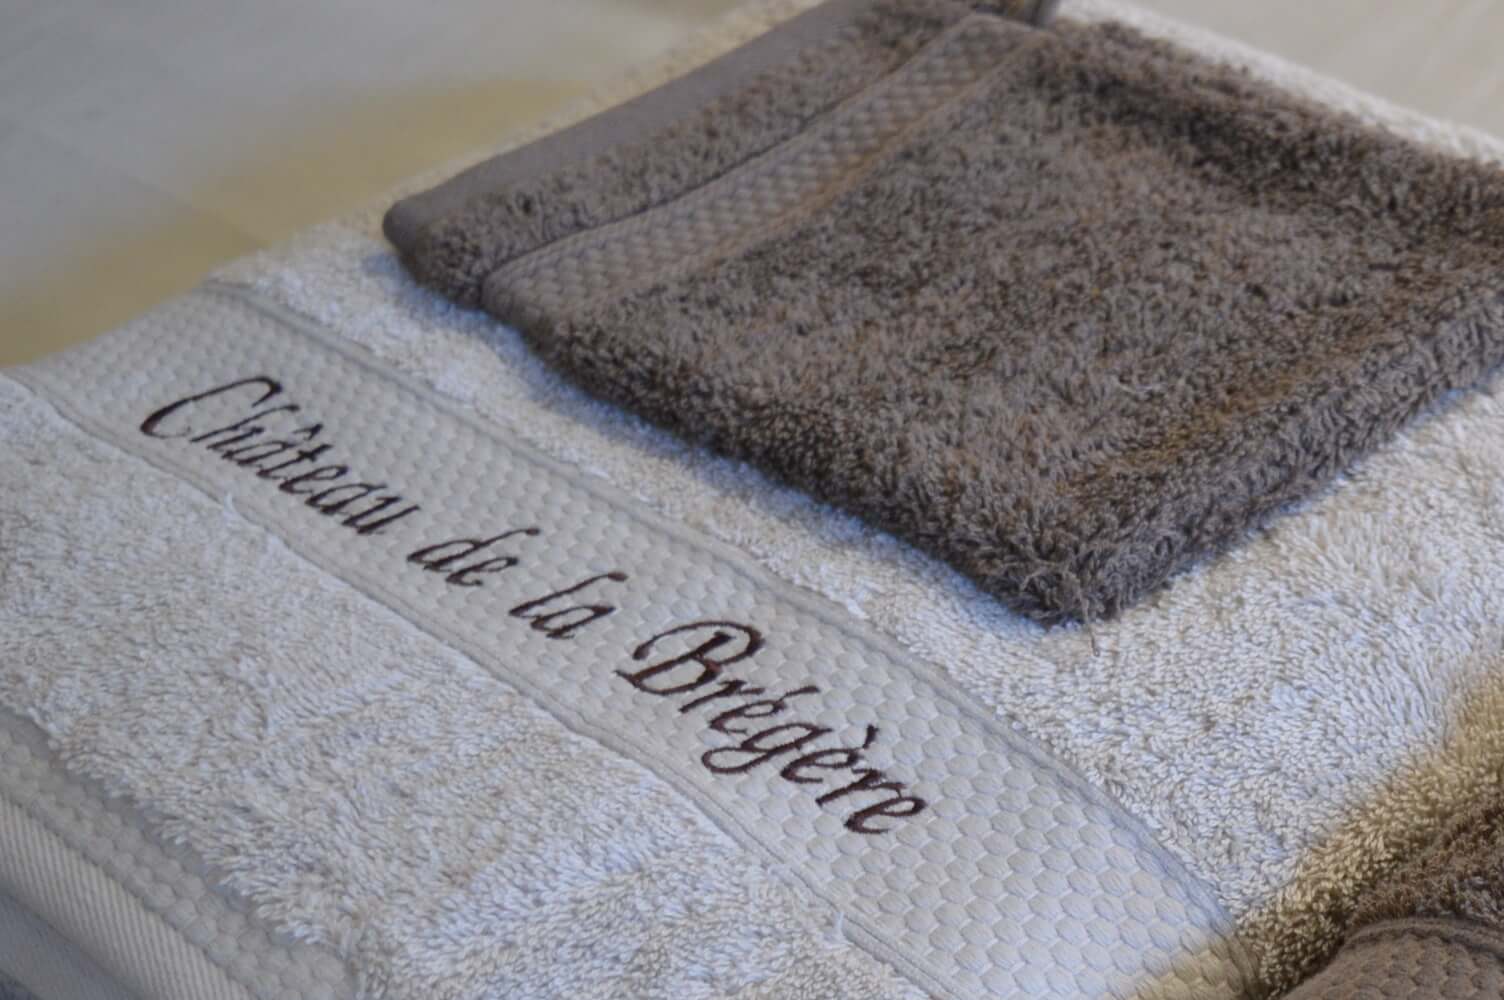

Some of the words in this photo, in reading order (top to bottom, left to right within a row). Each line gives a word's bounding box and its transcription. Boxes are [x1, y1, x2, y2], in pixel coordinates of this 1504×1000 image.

[140, 375, 420, 536] Château
[407, 527, 541, 588] de
[508, 571, 628, 640] la
[615, 620, 927, 834] Brégère
